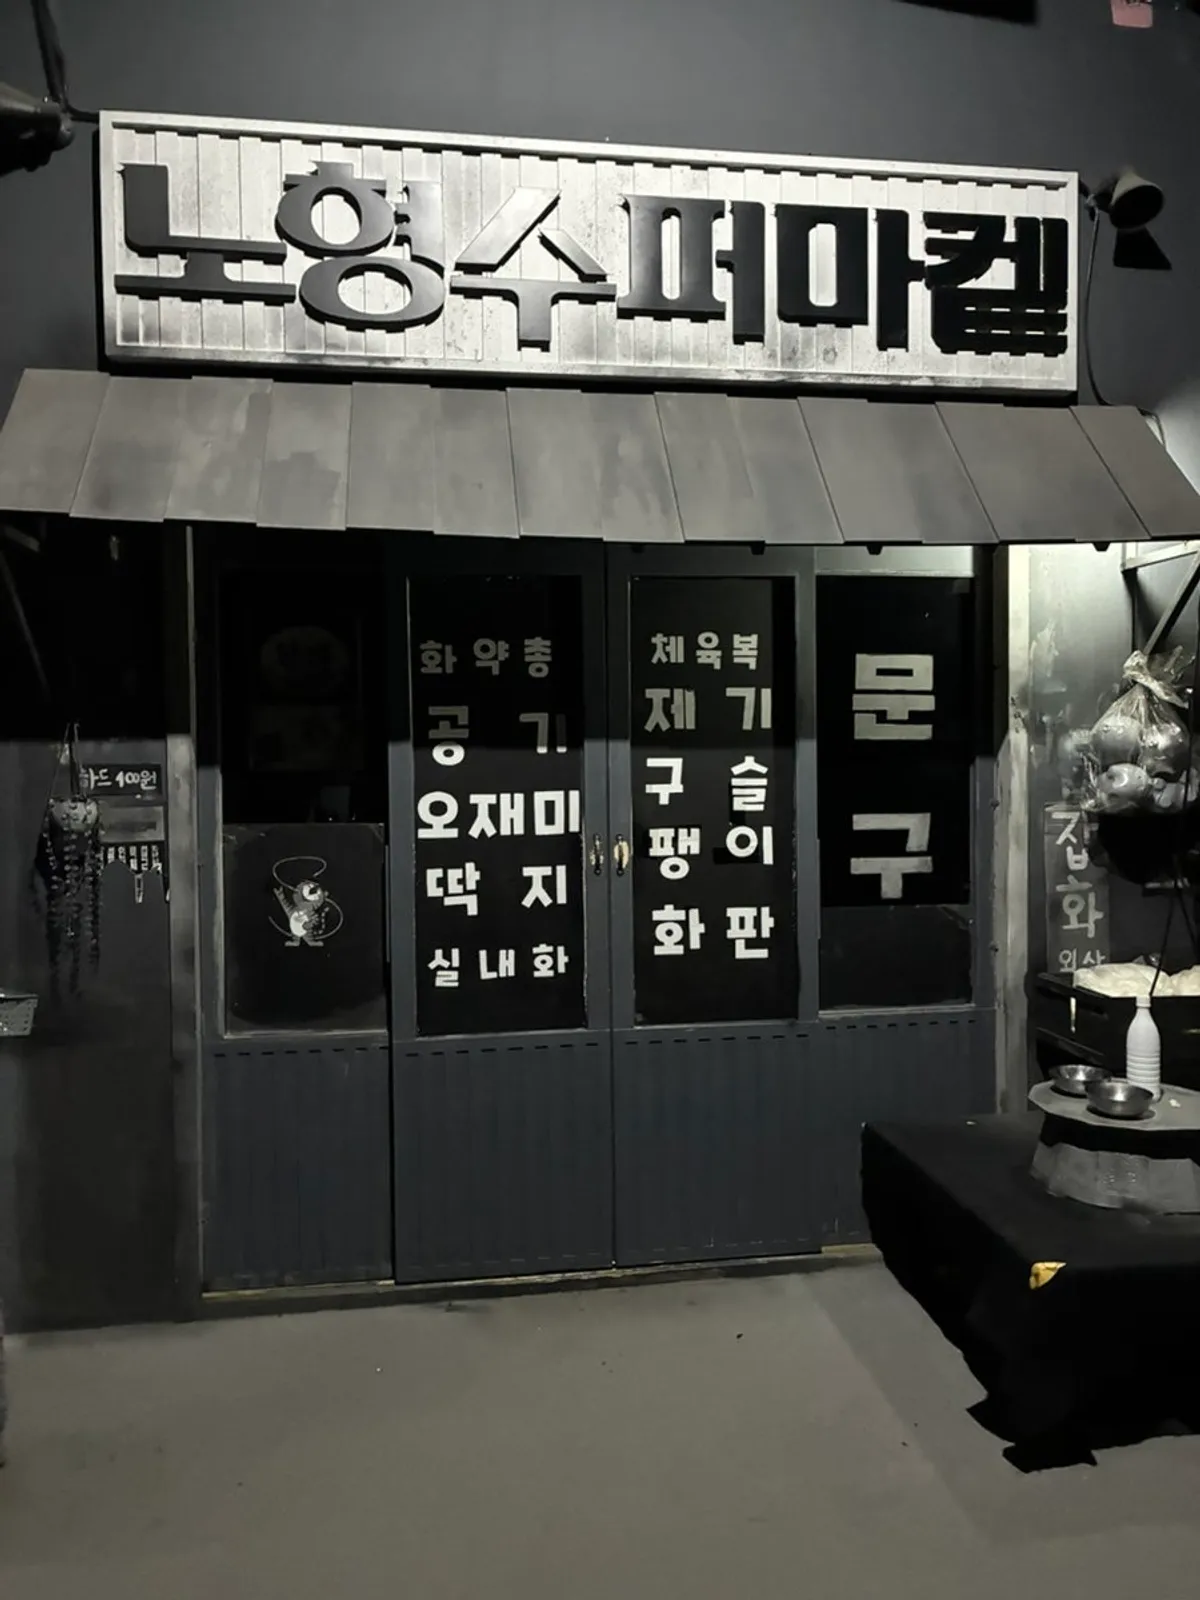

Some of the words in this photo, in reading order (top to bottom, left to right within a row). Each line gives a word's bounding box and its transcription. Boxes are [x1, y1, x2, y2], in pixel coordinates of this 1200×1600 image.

[419, 636, 553, 679] 화약총
[650, 632, 759, 671] 체육복
[427, 705, 569, 767] 공기
[643, 685, 773, 732] 제기
[644, 754, 769, 812] 구슬
[849, 652, 936, 900] 문구
[416, 789, 581, 840] 오재미
[648, 825, 775, 881] 팽이
[425, 861, 568, 917] 딱지
[650, 903, 776, 960] 화판
[427, 942, 570, 988] 실내화
